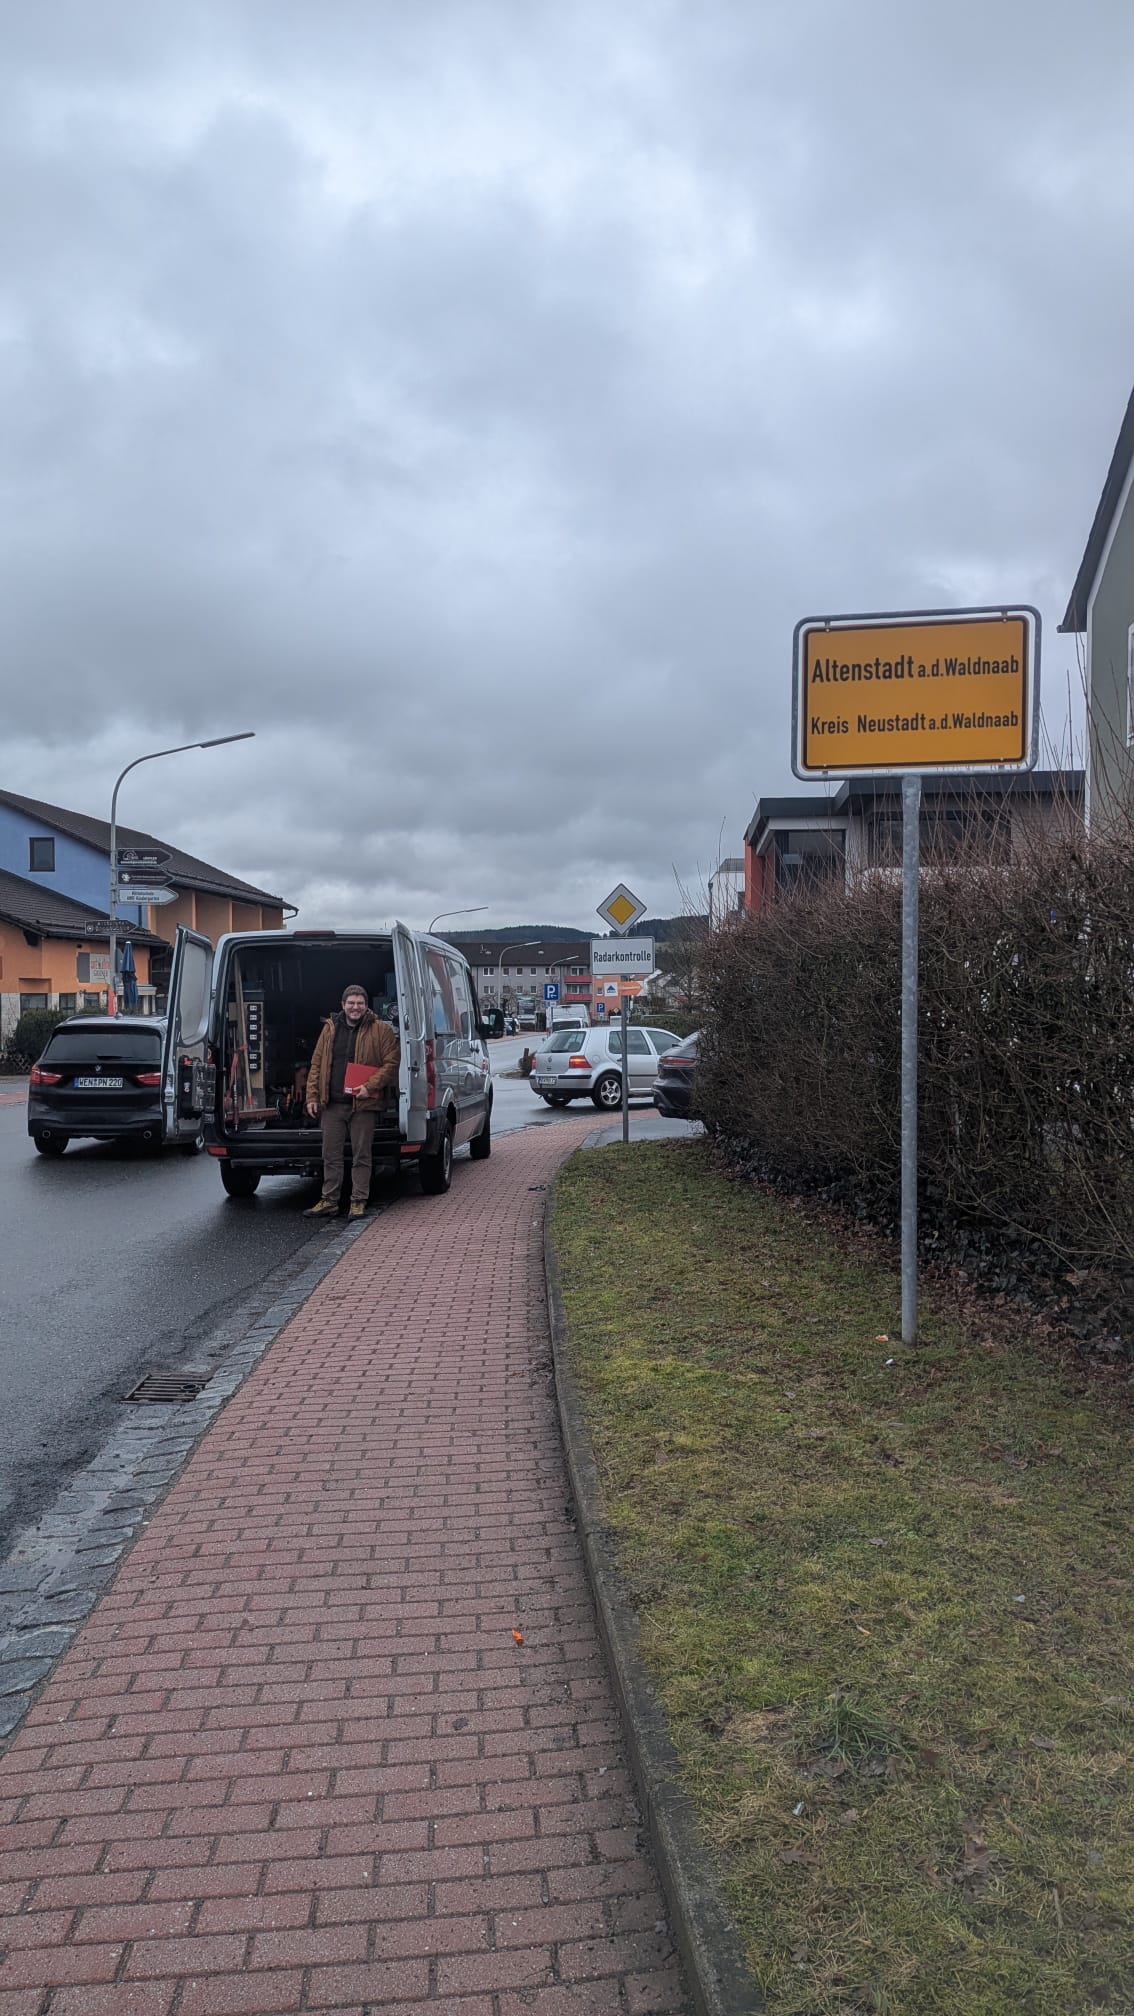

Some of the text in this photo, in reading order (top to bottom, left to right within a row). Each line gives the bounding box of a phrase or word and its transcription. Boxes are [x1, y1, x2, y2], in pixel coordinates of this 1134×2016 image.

[811, 655, 914, 683] Altenstadt
[811, 716, 849, 735] Kreis
[857, 712, 926, 733] Neustadt
[593, 950, 652, 963] Radarkontrolle
[547, 985, 556, 999] P
